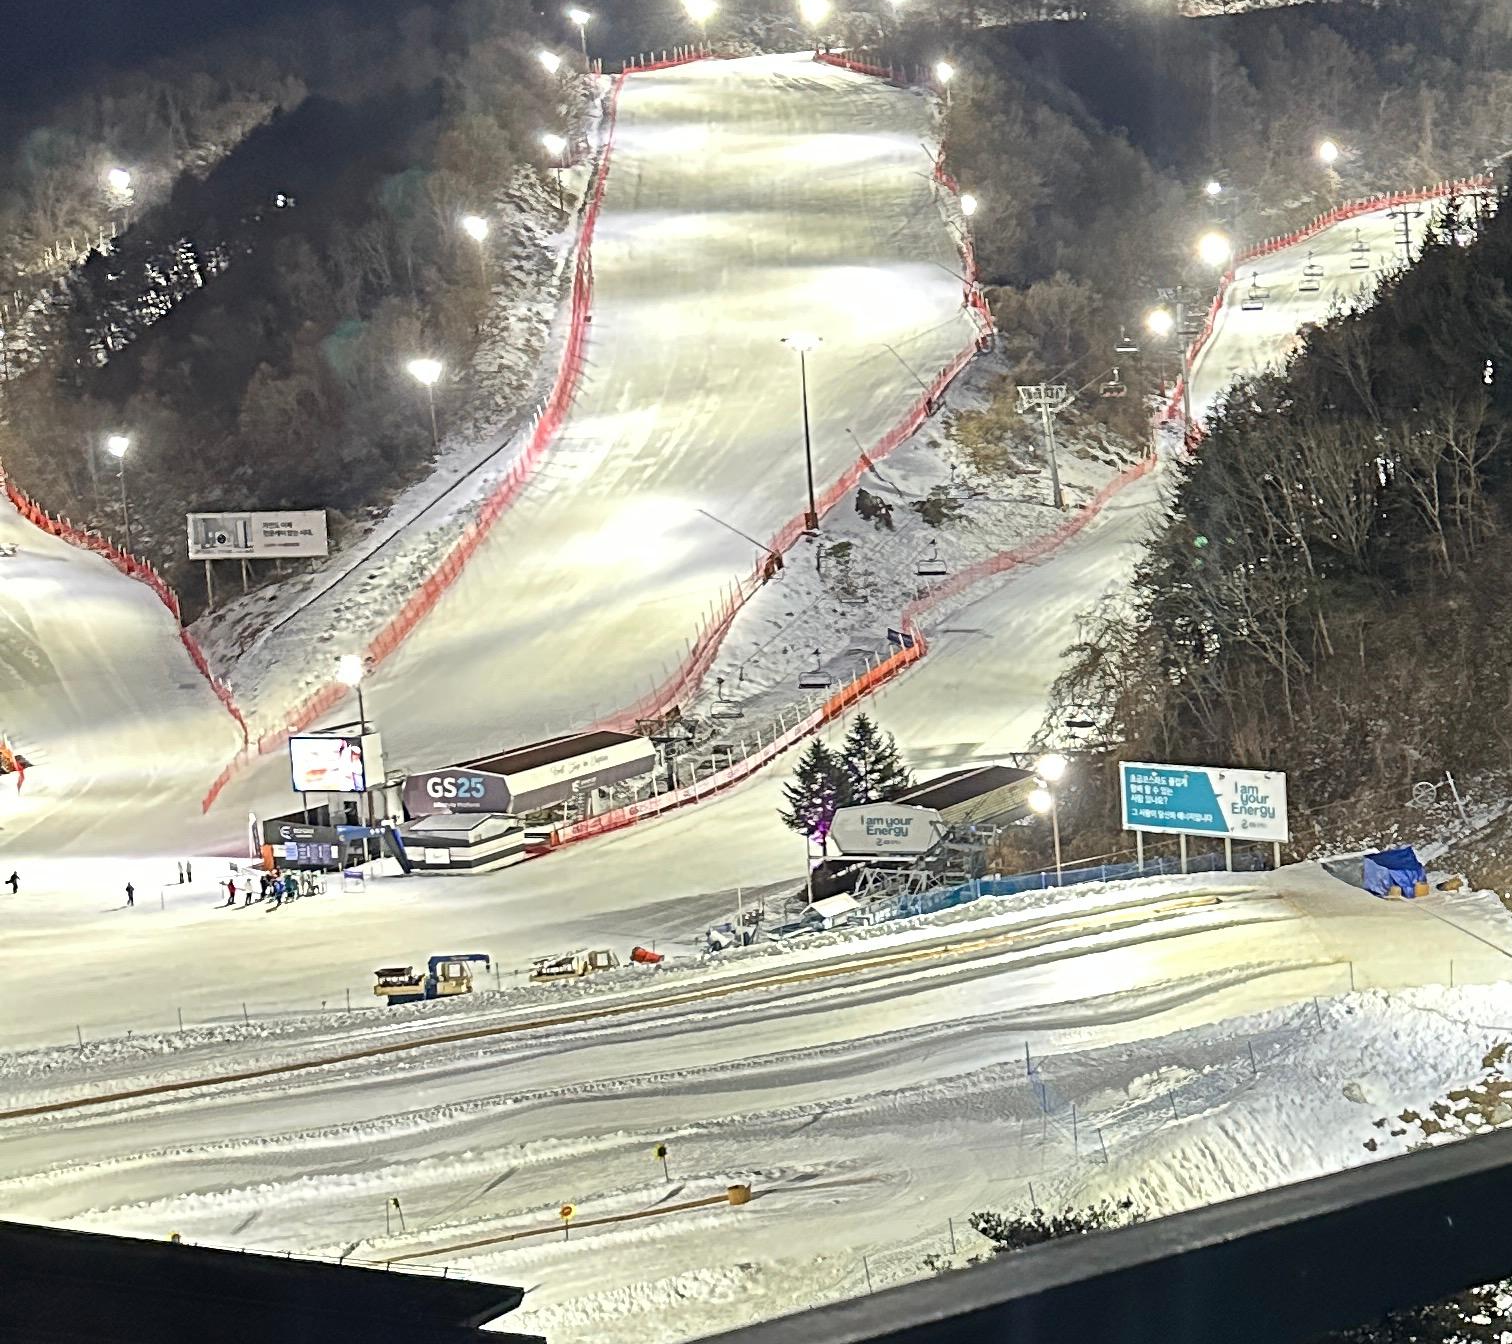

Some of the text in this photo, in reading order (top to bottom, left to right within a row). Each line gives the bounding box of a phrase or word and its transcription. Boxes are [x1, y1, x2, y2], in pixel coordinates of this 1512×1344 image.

[426, 777, 485, 798] GS25
[1240, 785, 1259, 795] am
[1240, 794, 1269, 806] your
[1231, 802, 1276, 819] Energy
[866, 817, 883, 825] am
[886, 817, 914, 828] your
[866, 825, 909, 837] Energy
